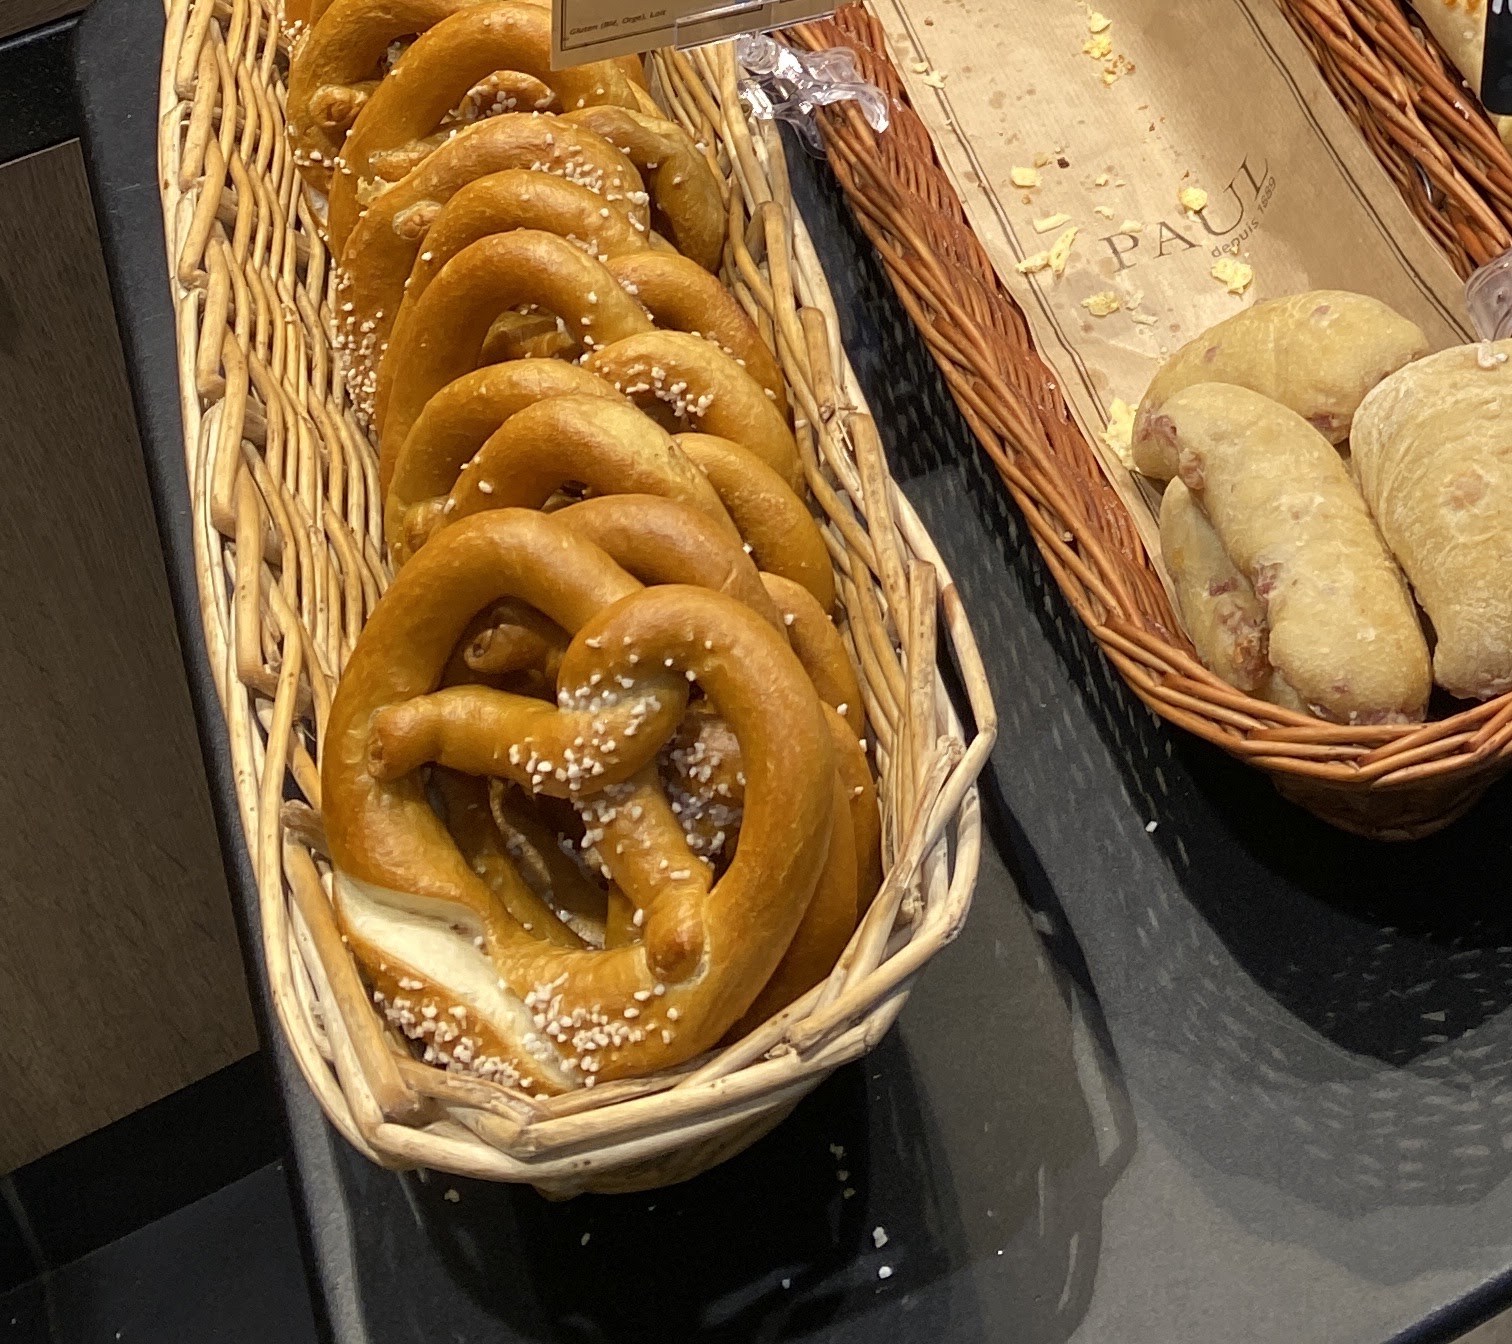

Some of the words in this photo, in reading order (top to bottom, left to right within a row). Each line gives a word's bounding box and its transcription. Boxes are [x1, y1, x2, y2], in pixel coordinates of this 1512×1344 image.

[569, 23, 598, 36] Gluten
[650, 9, 666, 19] Lait
[1098, 153, 1268, 273] PAUL
[1211, 218, 1260, 258] depuis
[1257, 176, 1276, 214] 1889
